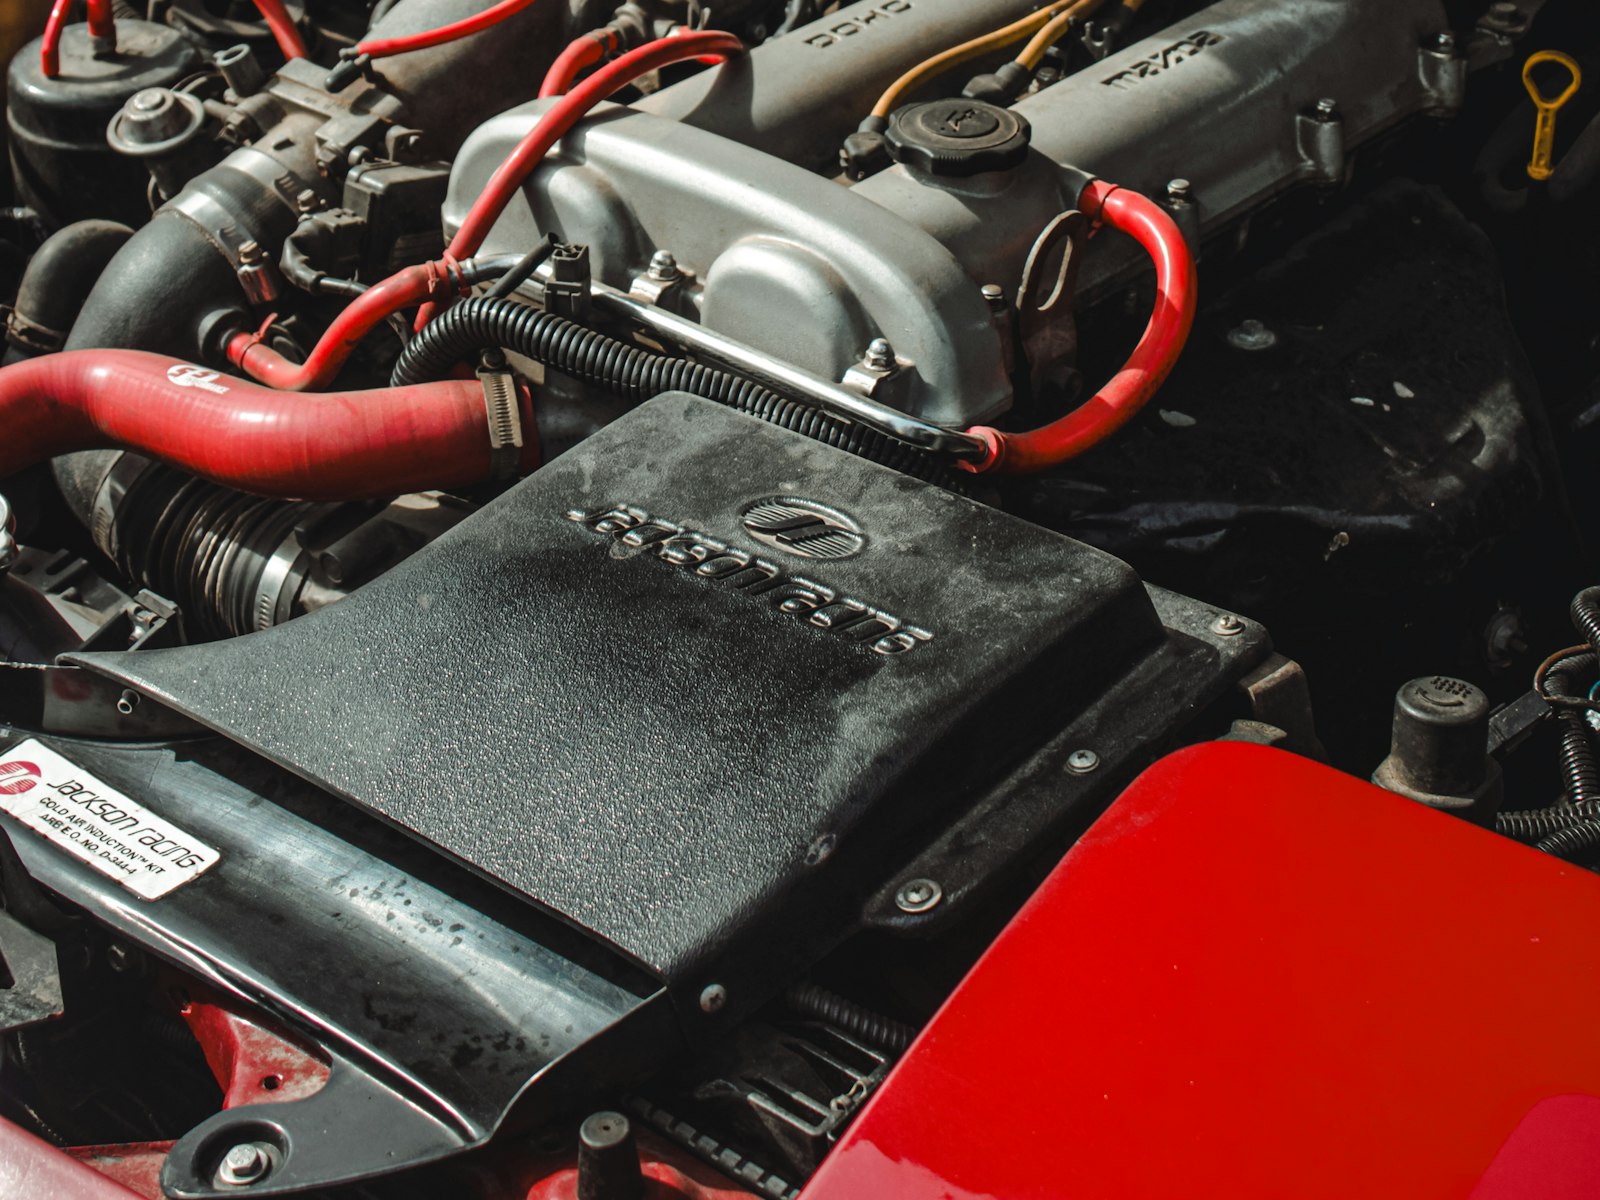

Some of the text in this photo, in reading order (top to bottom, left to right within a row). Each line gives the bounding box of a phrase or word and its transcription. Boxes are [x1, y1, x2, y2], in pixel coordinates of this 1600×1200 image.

[803, 0, 912, 49] DOHC
[39, 797, 69, 816] COLD
[66, 814, 88, 828] AIR
[145, 862, 167, 876] KIT
[80, 839, 100, 854] NO.
